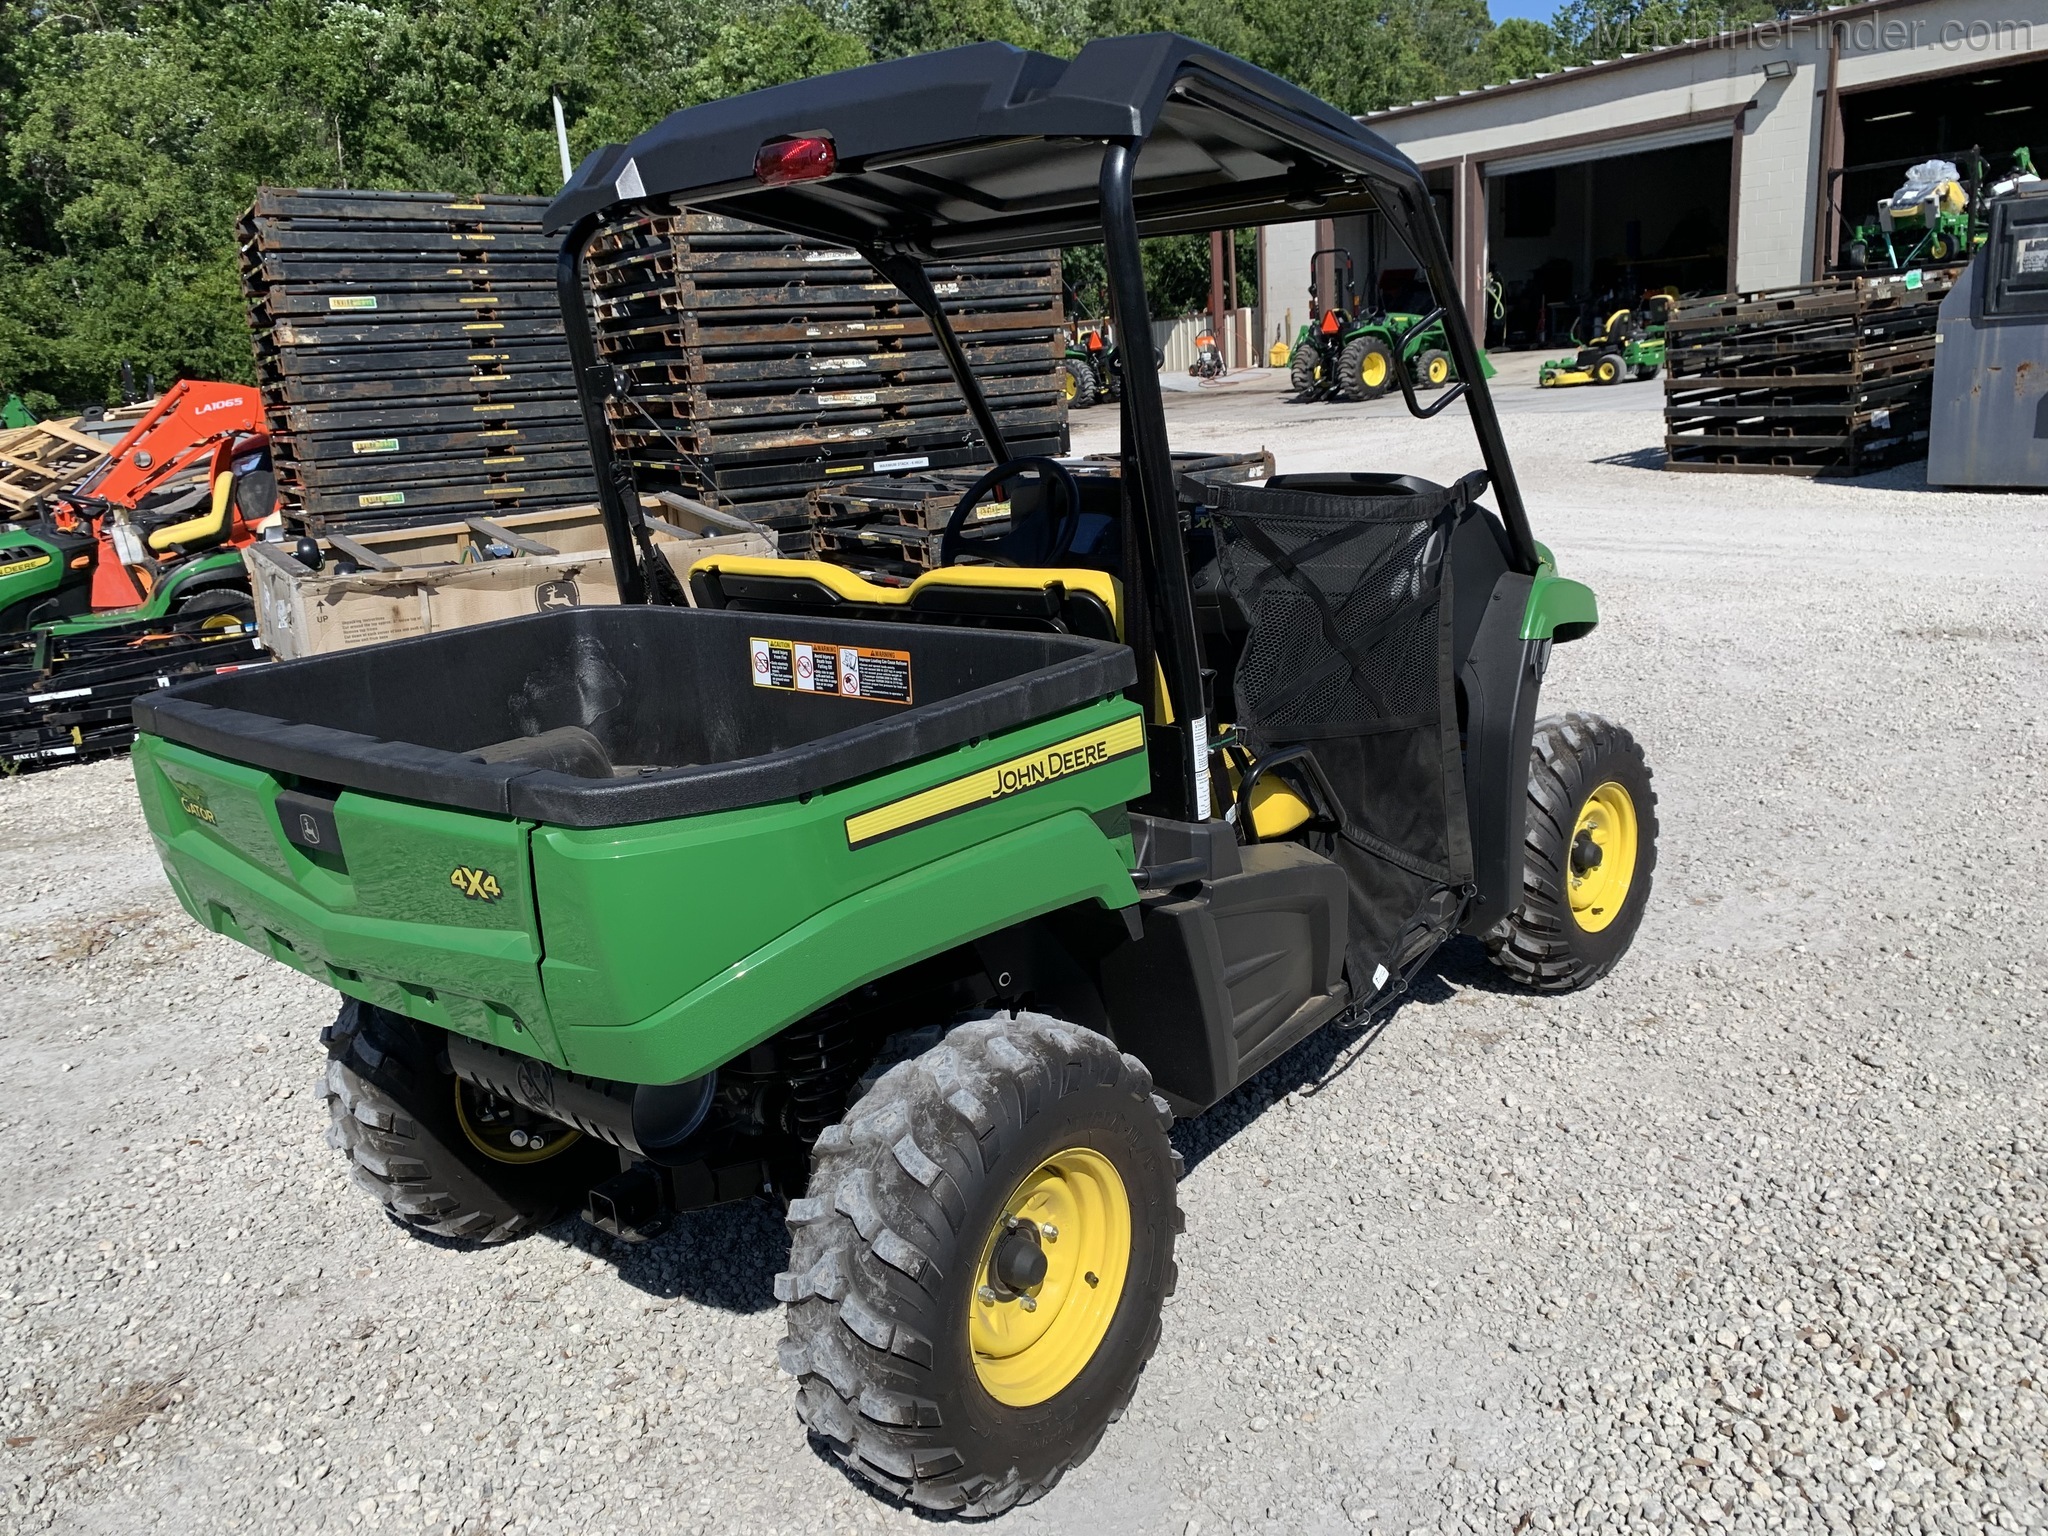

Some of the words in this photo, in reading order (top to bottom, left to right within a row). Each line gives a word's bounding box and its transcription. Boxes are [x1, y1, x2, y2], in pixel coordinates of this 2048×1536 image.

[195, 397, 243, 415] LA1065
[4, 561, 36, 574] DEERE
[992, 761, 1044, 794] JOHN
[1048, 741, 1108, 776] DEERE
[181, 797, 216, 824] GATOR
[451, 866, 500, 899] 4X4
